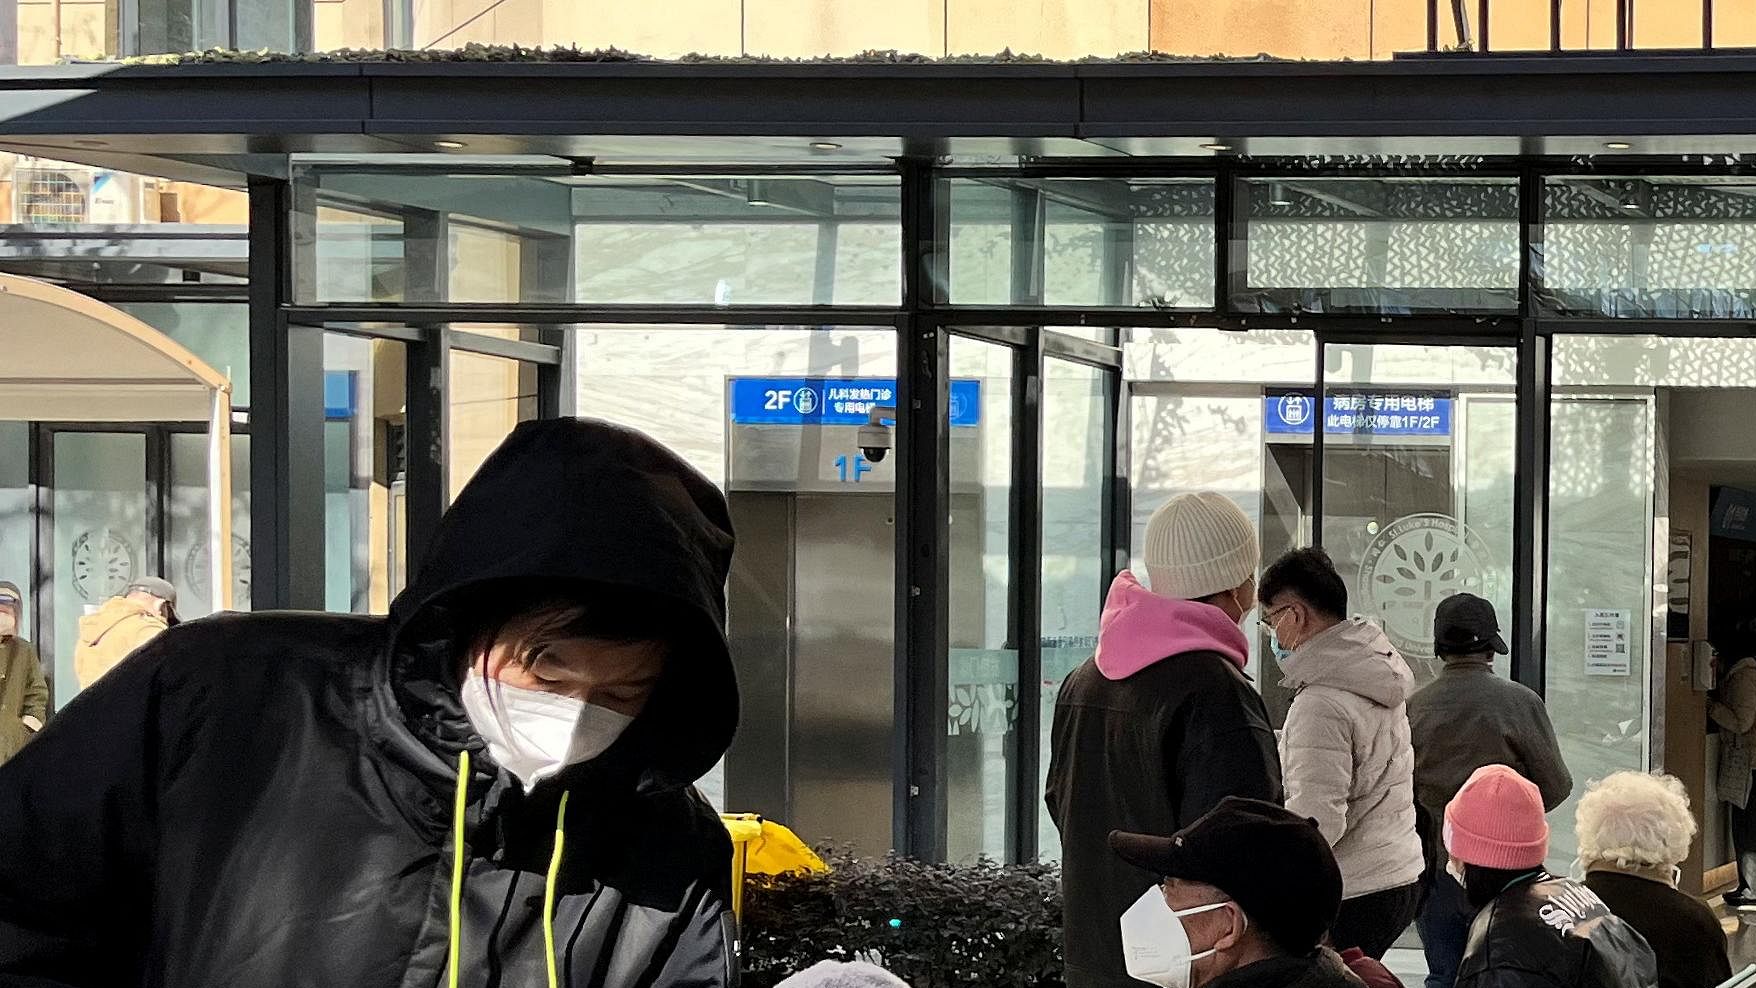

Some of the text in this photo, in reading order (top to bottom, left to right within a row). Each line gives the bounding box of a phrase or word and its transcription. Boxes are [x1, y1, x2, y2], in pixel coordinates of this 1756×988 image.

[764, 390, 792, 410] 2F
[1333, 394, 1434, 411] 病房专用电梯
[835, 454, 872, 482] 1F
